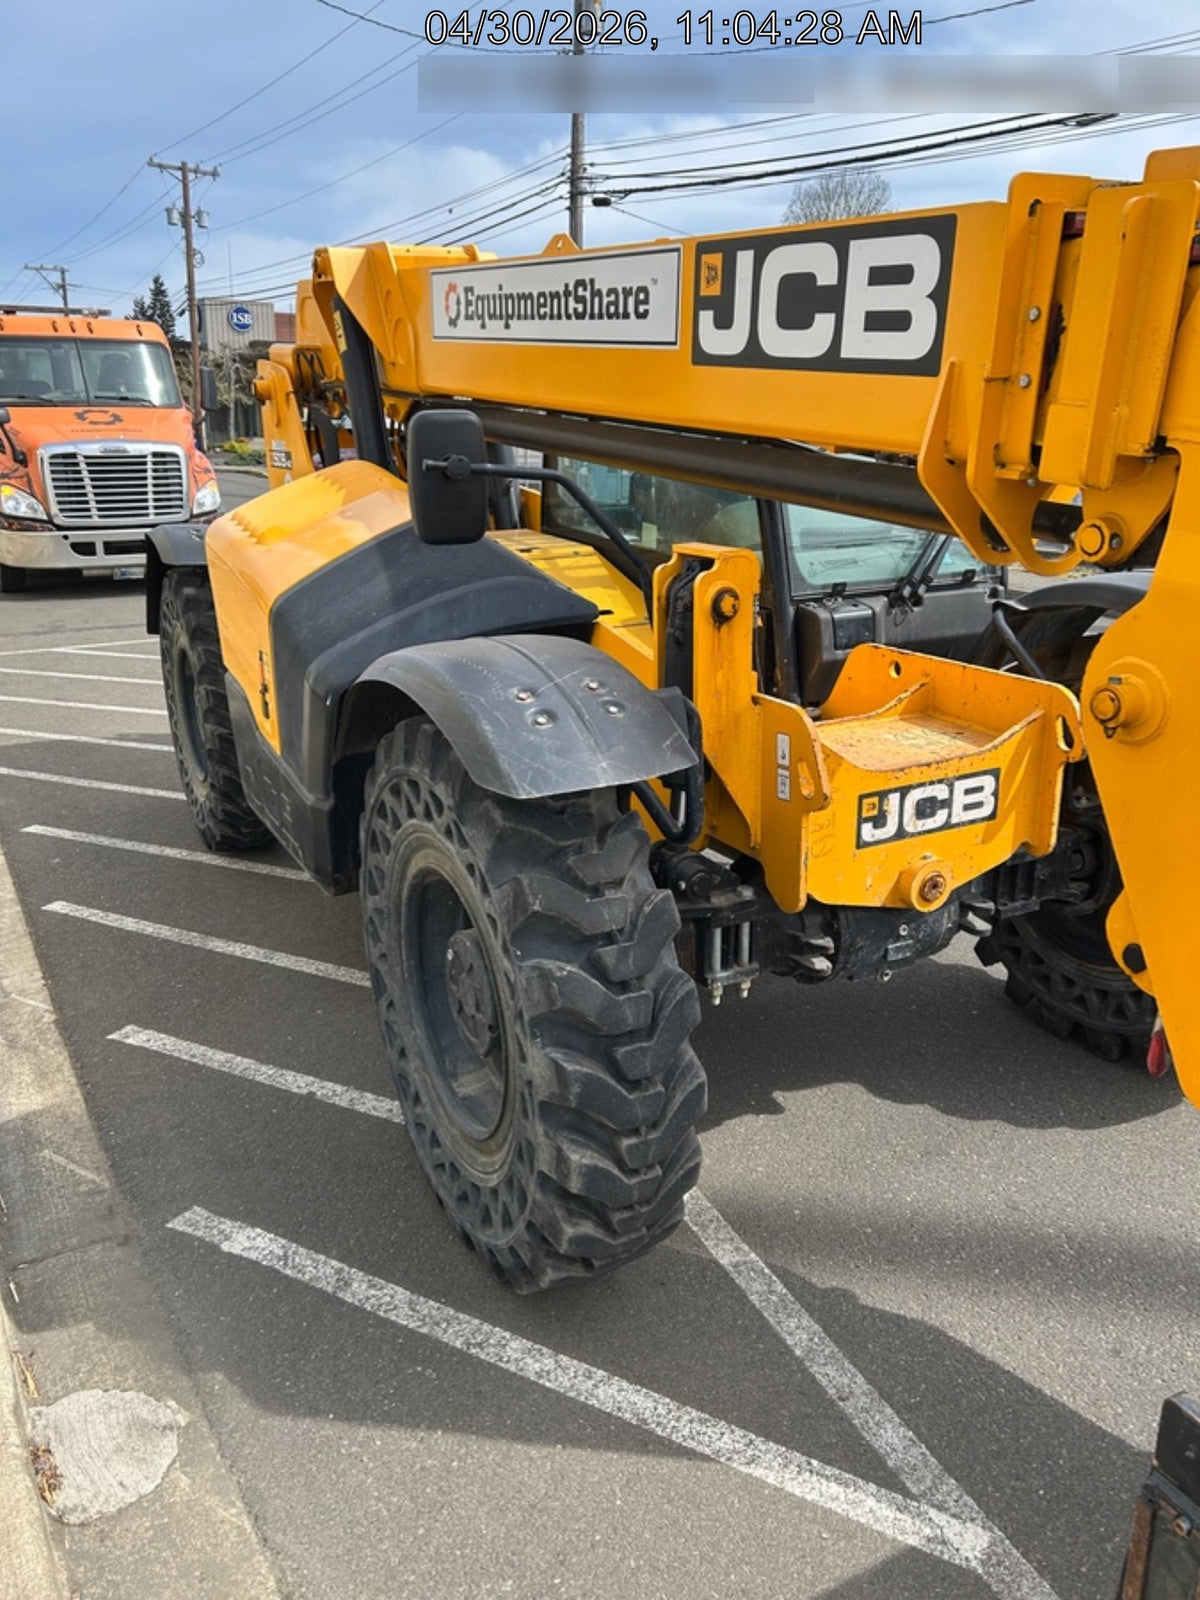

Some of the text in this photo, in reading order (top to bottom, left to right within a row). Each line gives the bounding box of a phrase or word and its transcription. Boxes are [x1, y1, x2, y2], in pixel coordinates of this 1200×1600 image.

[464, 278, 650, 329] EquipmentShare
[699, 233, 941, 361] JCB
[860, 774, 996, 842] JCB
